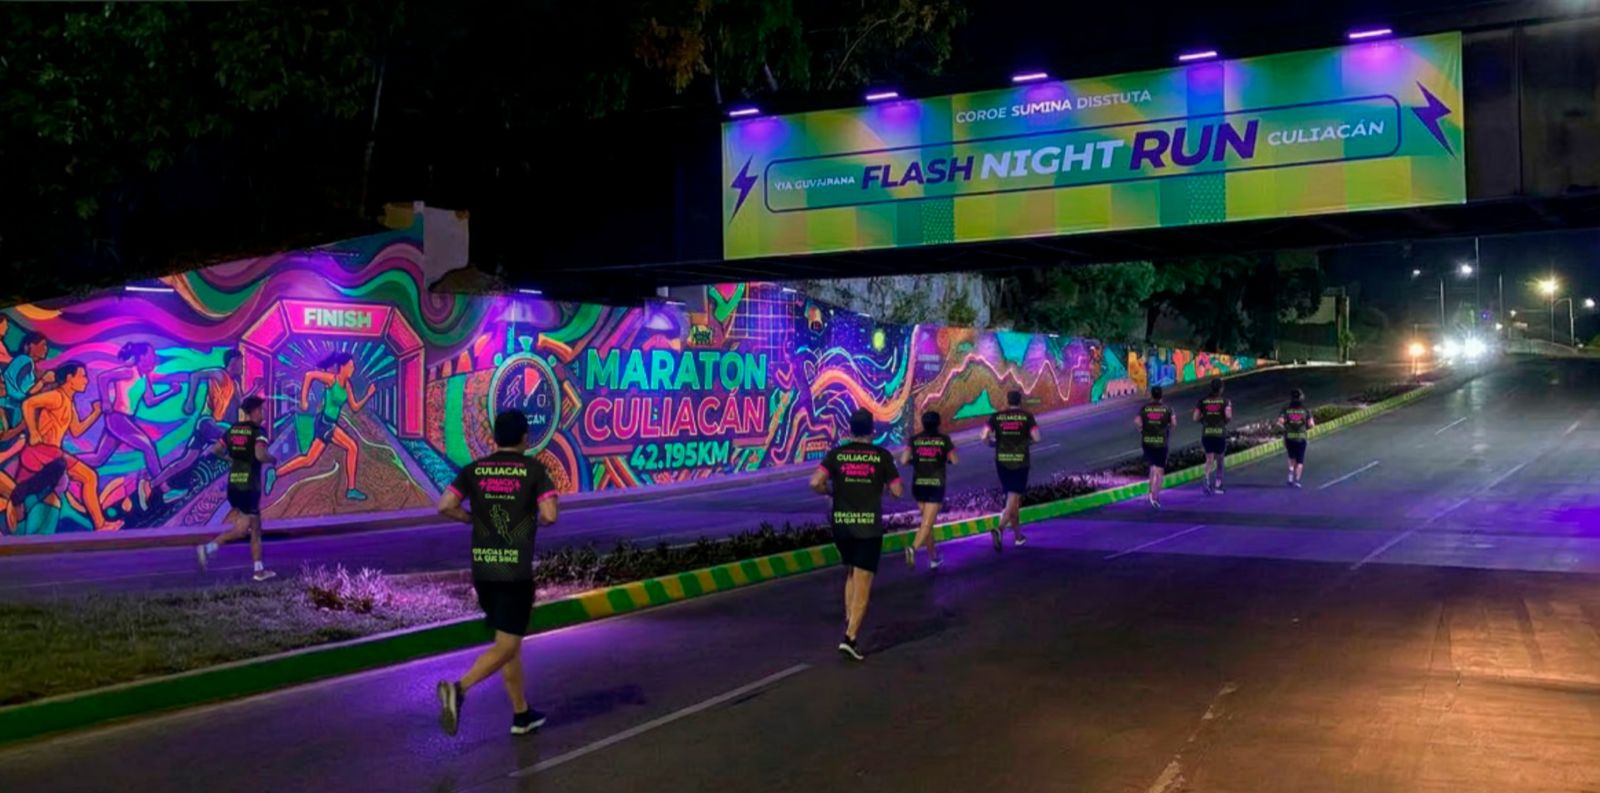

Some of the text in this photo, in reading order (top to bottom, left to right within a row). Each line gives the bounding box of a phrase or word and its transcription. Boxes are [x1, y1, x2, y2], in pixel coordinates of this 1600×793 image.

[956, 107, 1007, 123] COROE
[1011, 99, 1072, 117] SUMINA
[861, 155, 974, 190] FLASH
[980, 139, 1124, 180] NIGHT
[1129, 119, 1259, 171] RUN
[1267, 120, 1385, 146] CULIACÁN
[304, 307, 371, 328] FINISH
[584, 387, 766, 441] CULIACÁN
[630, 440, 730, 471] 42.195KM
